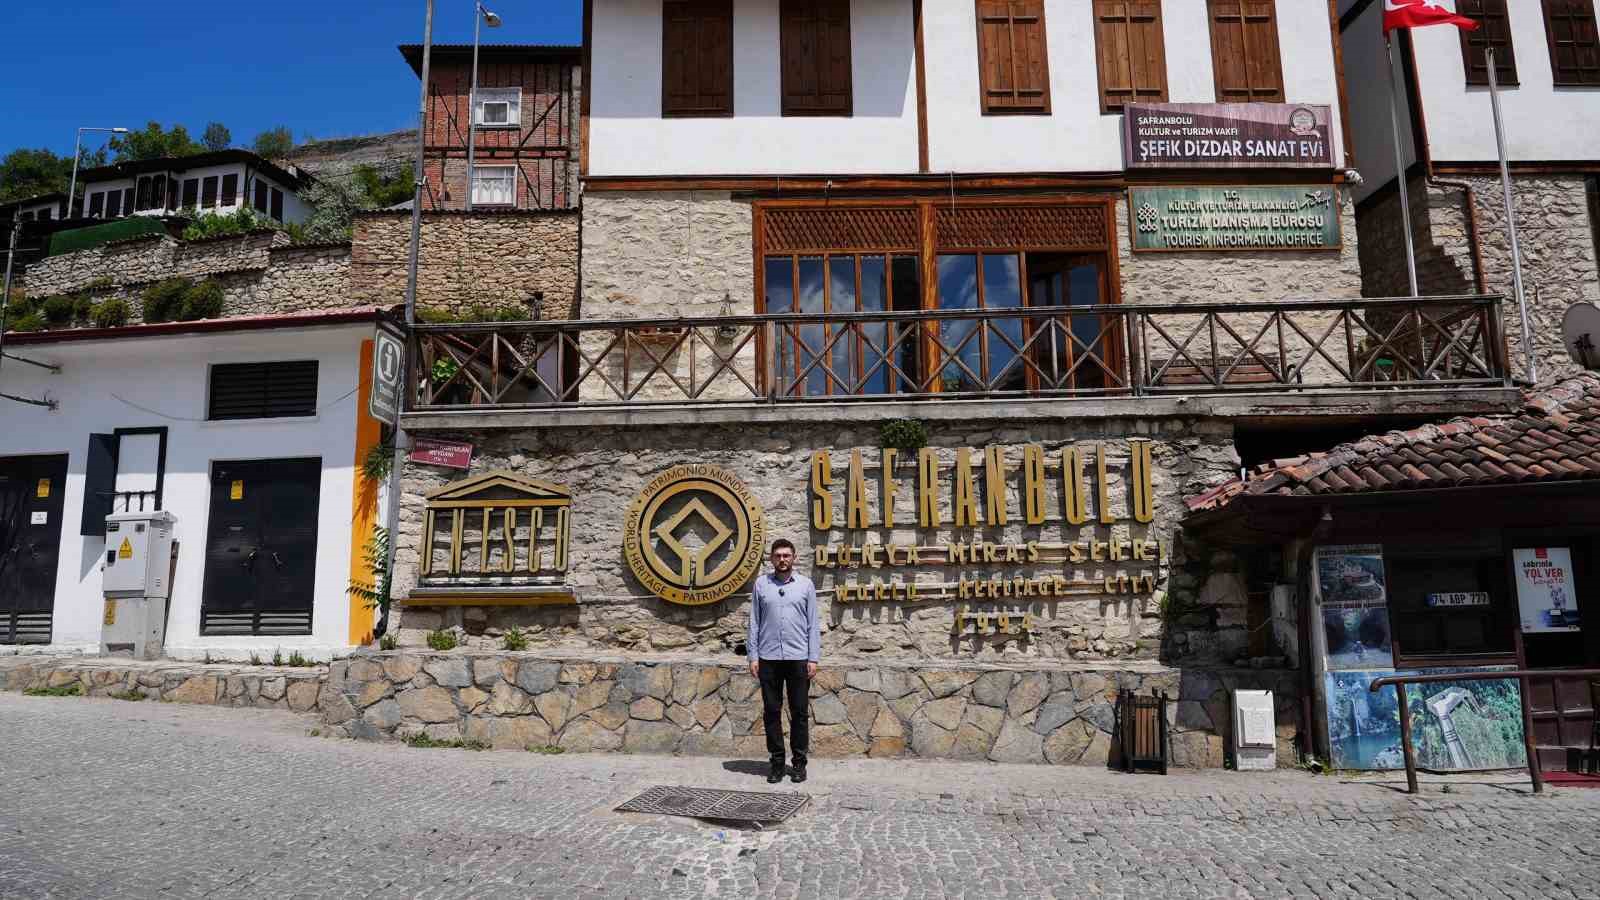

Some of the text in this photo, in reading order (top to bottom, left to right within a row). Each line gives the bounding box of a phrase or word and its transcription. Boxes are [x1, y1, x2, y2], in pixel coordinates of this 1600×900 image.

[1138, 116, 1193, 125] SAFRANBOLU
[1139, 140, 1323, 161] ŞEFİK DİZDAR SANAT EVİ
[1161, 215, 1212, 229] TURİZM
[1163, 232, 1323, 247] TOURISM INFORMATION OFFICE
[642, 466, 752, 504] PATRIMONIO MUNDIAL
[810, 440, 1153, 530] SAFRANBOLU
[419, 506, 570, 576] UNESCO
[626, 509, 667, 594] WORLD HERITAGE
[683, 516, 762, 601] PATRIMOINE MONDIAL
[1523, 567, 1564, 578] YOL VER
[834, 575, 1154, 602] WORLD HERITAGE CITY
[957, 609, 1034, 634] 1994
